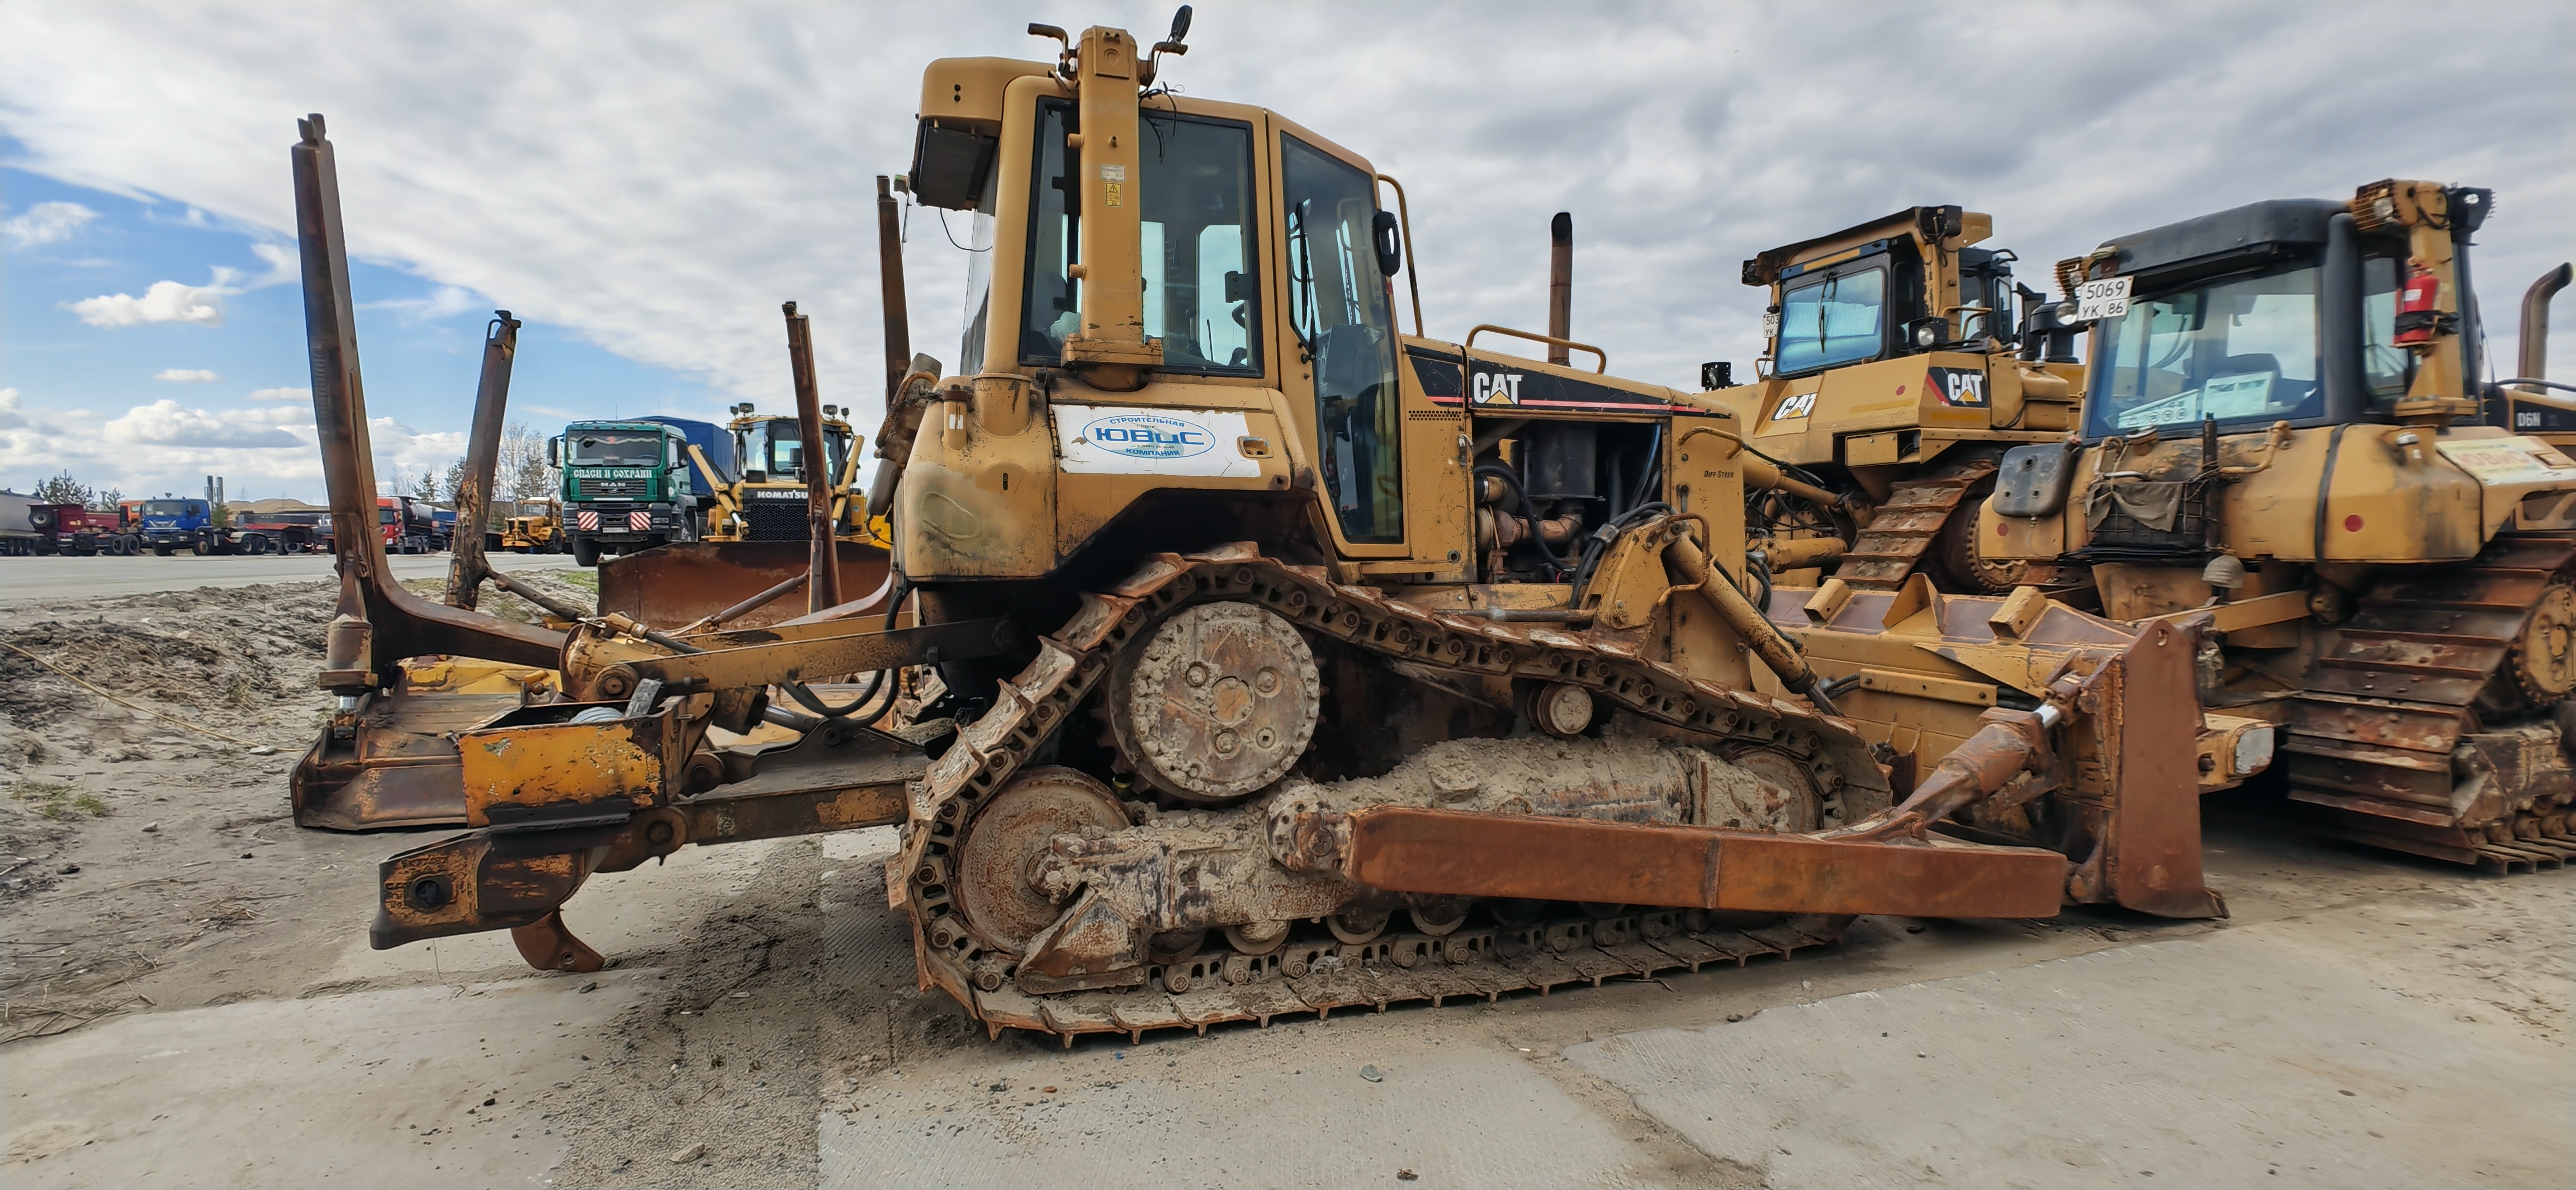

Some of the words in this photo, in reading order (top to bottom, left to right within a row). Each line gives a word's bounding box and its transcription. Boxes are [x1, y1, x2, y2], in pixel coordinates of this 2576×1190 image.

[2086, 280, 2125, 300] 5069
[2082, 304, 2100, 318] УК
[2108, 301, 2124, 315] 86
[1474, 372, 1522, 405] CAT
[1948, 372, 1983, 403] CAT
[1774, 393, 1817, 420] CAT
[1109, 417, 1186, 428] СТРОИТЕЛЬНАЯ
[2517, 412, 2541, 427] D6N
[1125, 447, 1181, 457] КОМПАНИЯ
[574, 469, 602, 478] СПАСИ
[604, 469, 611, 478] И
[613, 469, 652, 478] СОХРАНИ
[757, 489, 808, 499] KOMATSU
